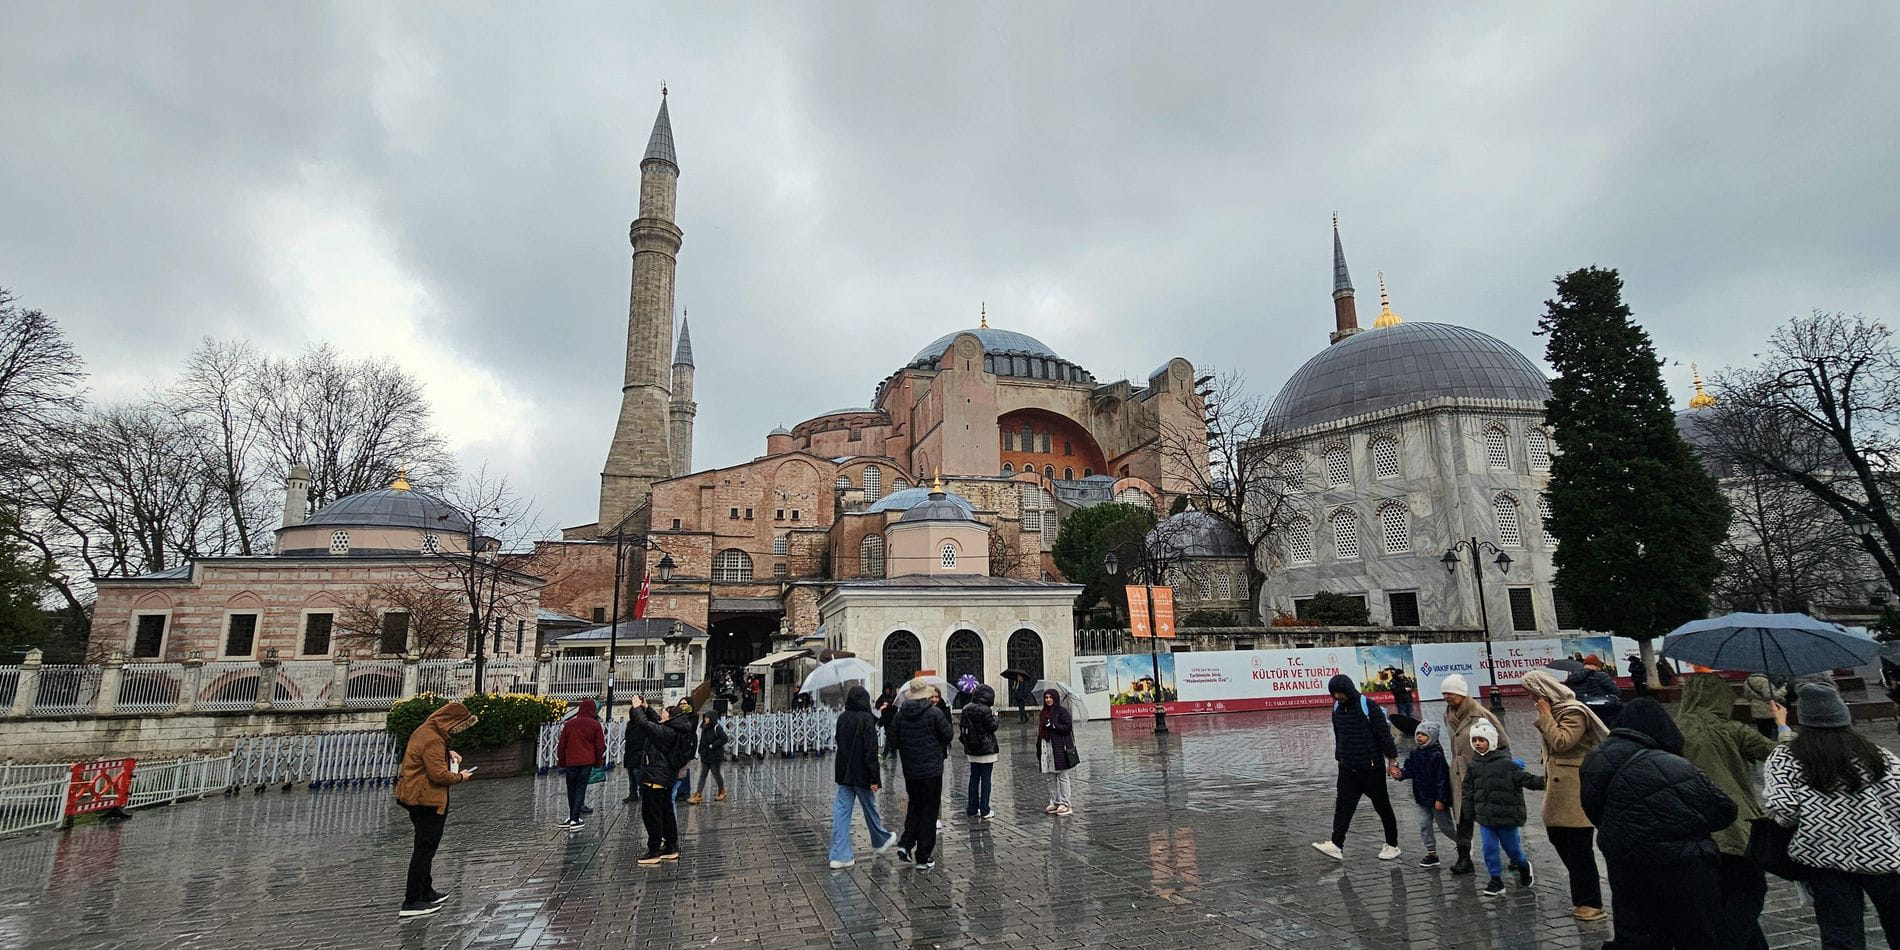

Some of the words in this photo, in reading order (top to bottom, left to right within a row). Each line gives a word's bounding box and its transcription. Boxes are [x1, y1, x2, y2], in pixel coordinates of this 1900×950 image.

[1508, 648, 1523, 657] T.C.
[1287, 657, 1304, 666] T.C.
[1480, 658, 1511, 669] KTÜR
[1512, 659, 1523, 668] VE
[1252, 667, 1289, 680] KÜLTÜR
[1290, 668, 1303, 678] VE
[1305, 666, 1339, 678] TURİZM
[1272, 678, 1323, 691] BAKANLIĞI
